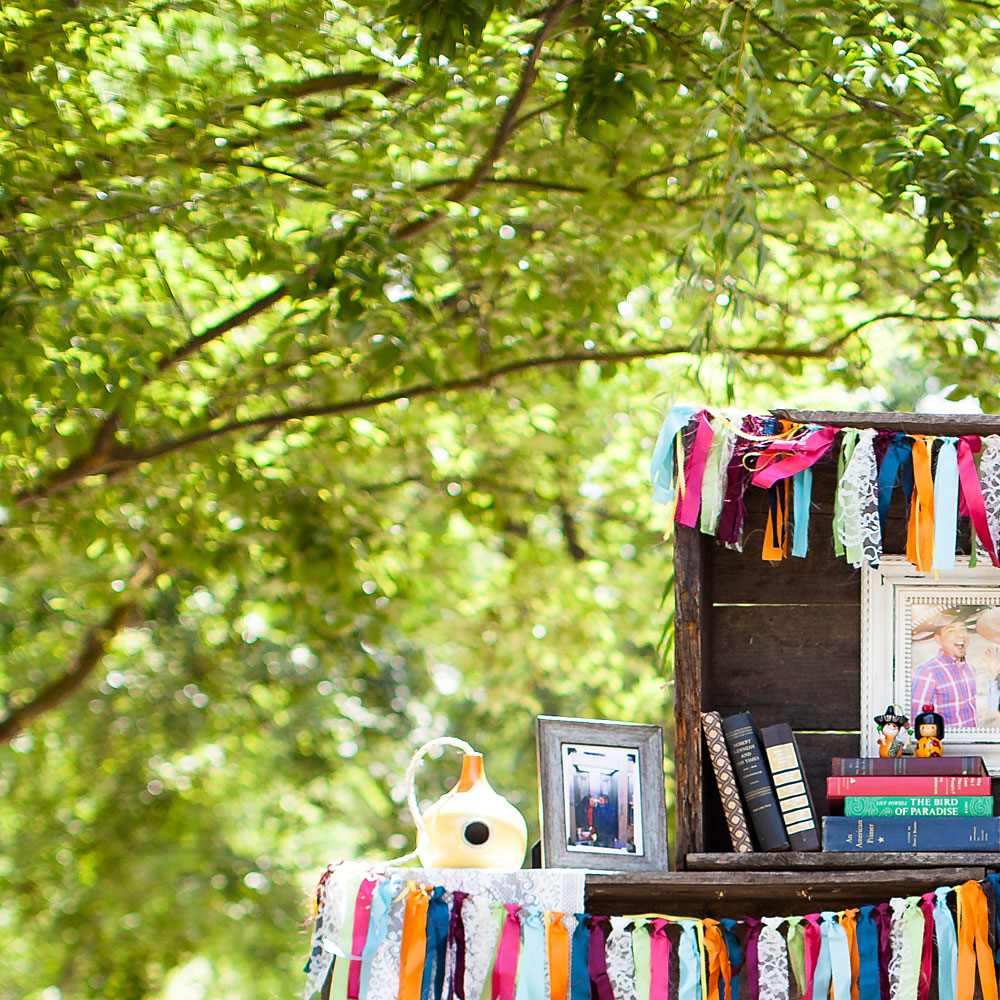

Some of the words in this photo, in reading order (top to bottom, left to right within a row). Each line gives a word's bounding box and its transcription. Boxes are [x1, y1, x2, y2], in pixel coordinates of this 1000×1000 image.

[910, 798, 931, 806] THE
[934, 798, 959, 806] BIRD
[894, 807, 909, 816] OF
[910, 807, 959, 816] PARADISE
[845, 833, 853, 843] An
[855, 819, 863, 848] American
[866, 823, 874, 844] Primer
